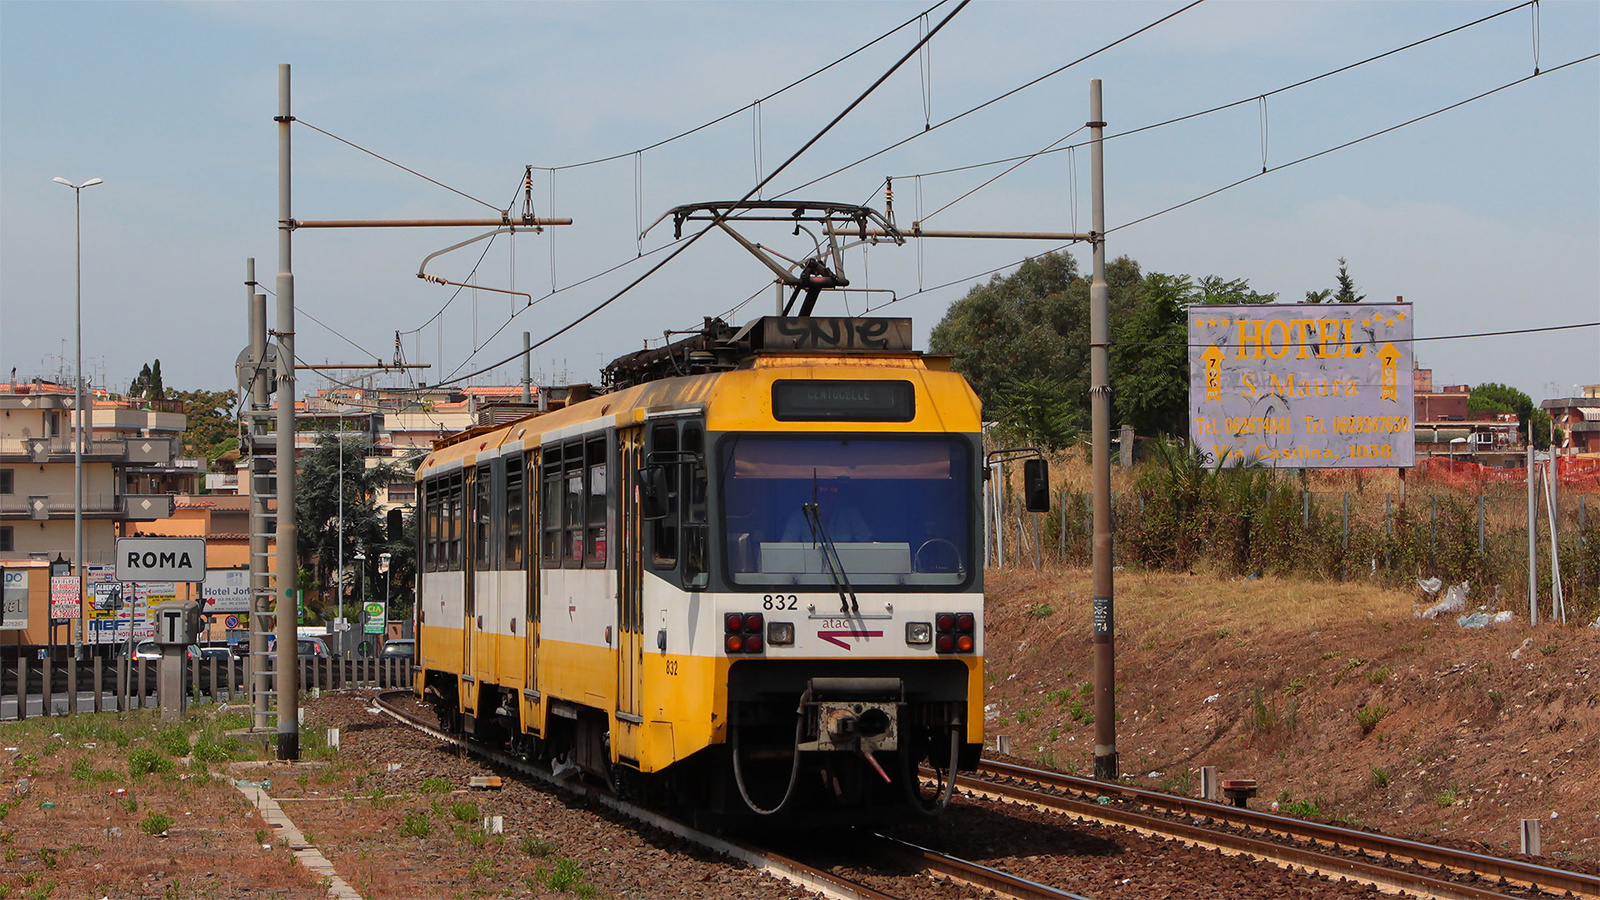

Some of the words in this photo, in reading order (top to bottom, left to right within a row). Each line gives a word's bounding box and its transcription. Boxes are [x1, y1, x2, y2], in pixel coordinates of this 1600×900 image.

[1235, 319, 1366, 359] HOTEL
[1268, 373, 1359, 397] Maura
[1195, 417, 1220, 434] Tel.
[1225, 417, 1291, 434] 062674041
[1304, 416, 1327, 434] Tel.
[1332, 416, 1409, 433] 0623267630
[1212, 445, 1244, 459] Via
[1254, 444, 1340, 460] Casilina,
[1349, 444, 1392, 459] 1038
[127, 551, 192, 569] ROMA
[204, 587, 230, 596] Hotel
[233, 587, 250, 596] Jon
[763, 594, 798, 611] 832
[164, 612, 181, 642] T
[822, 618, 850, 629] atac
[666, 660, 678, 676] 832
